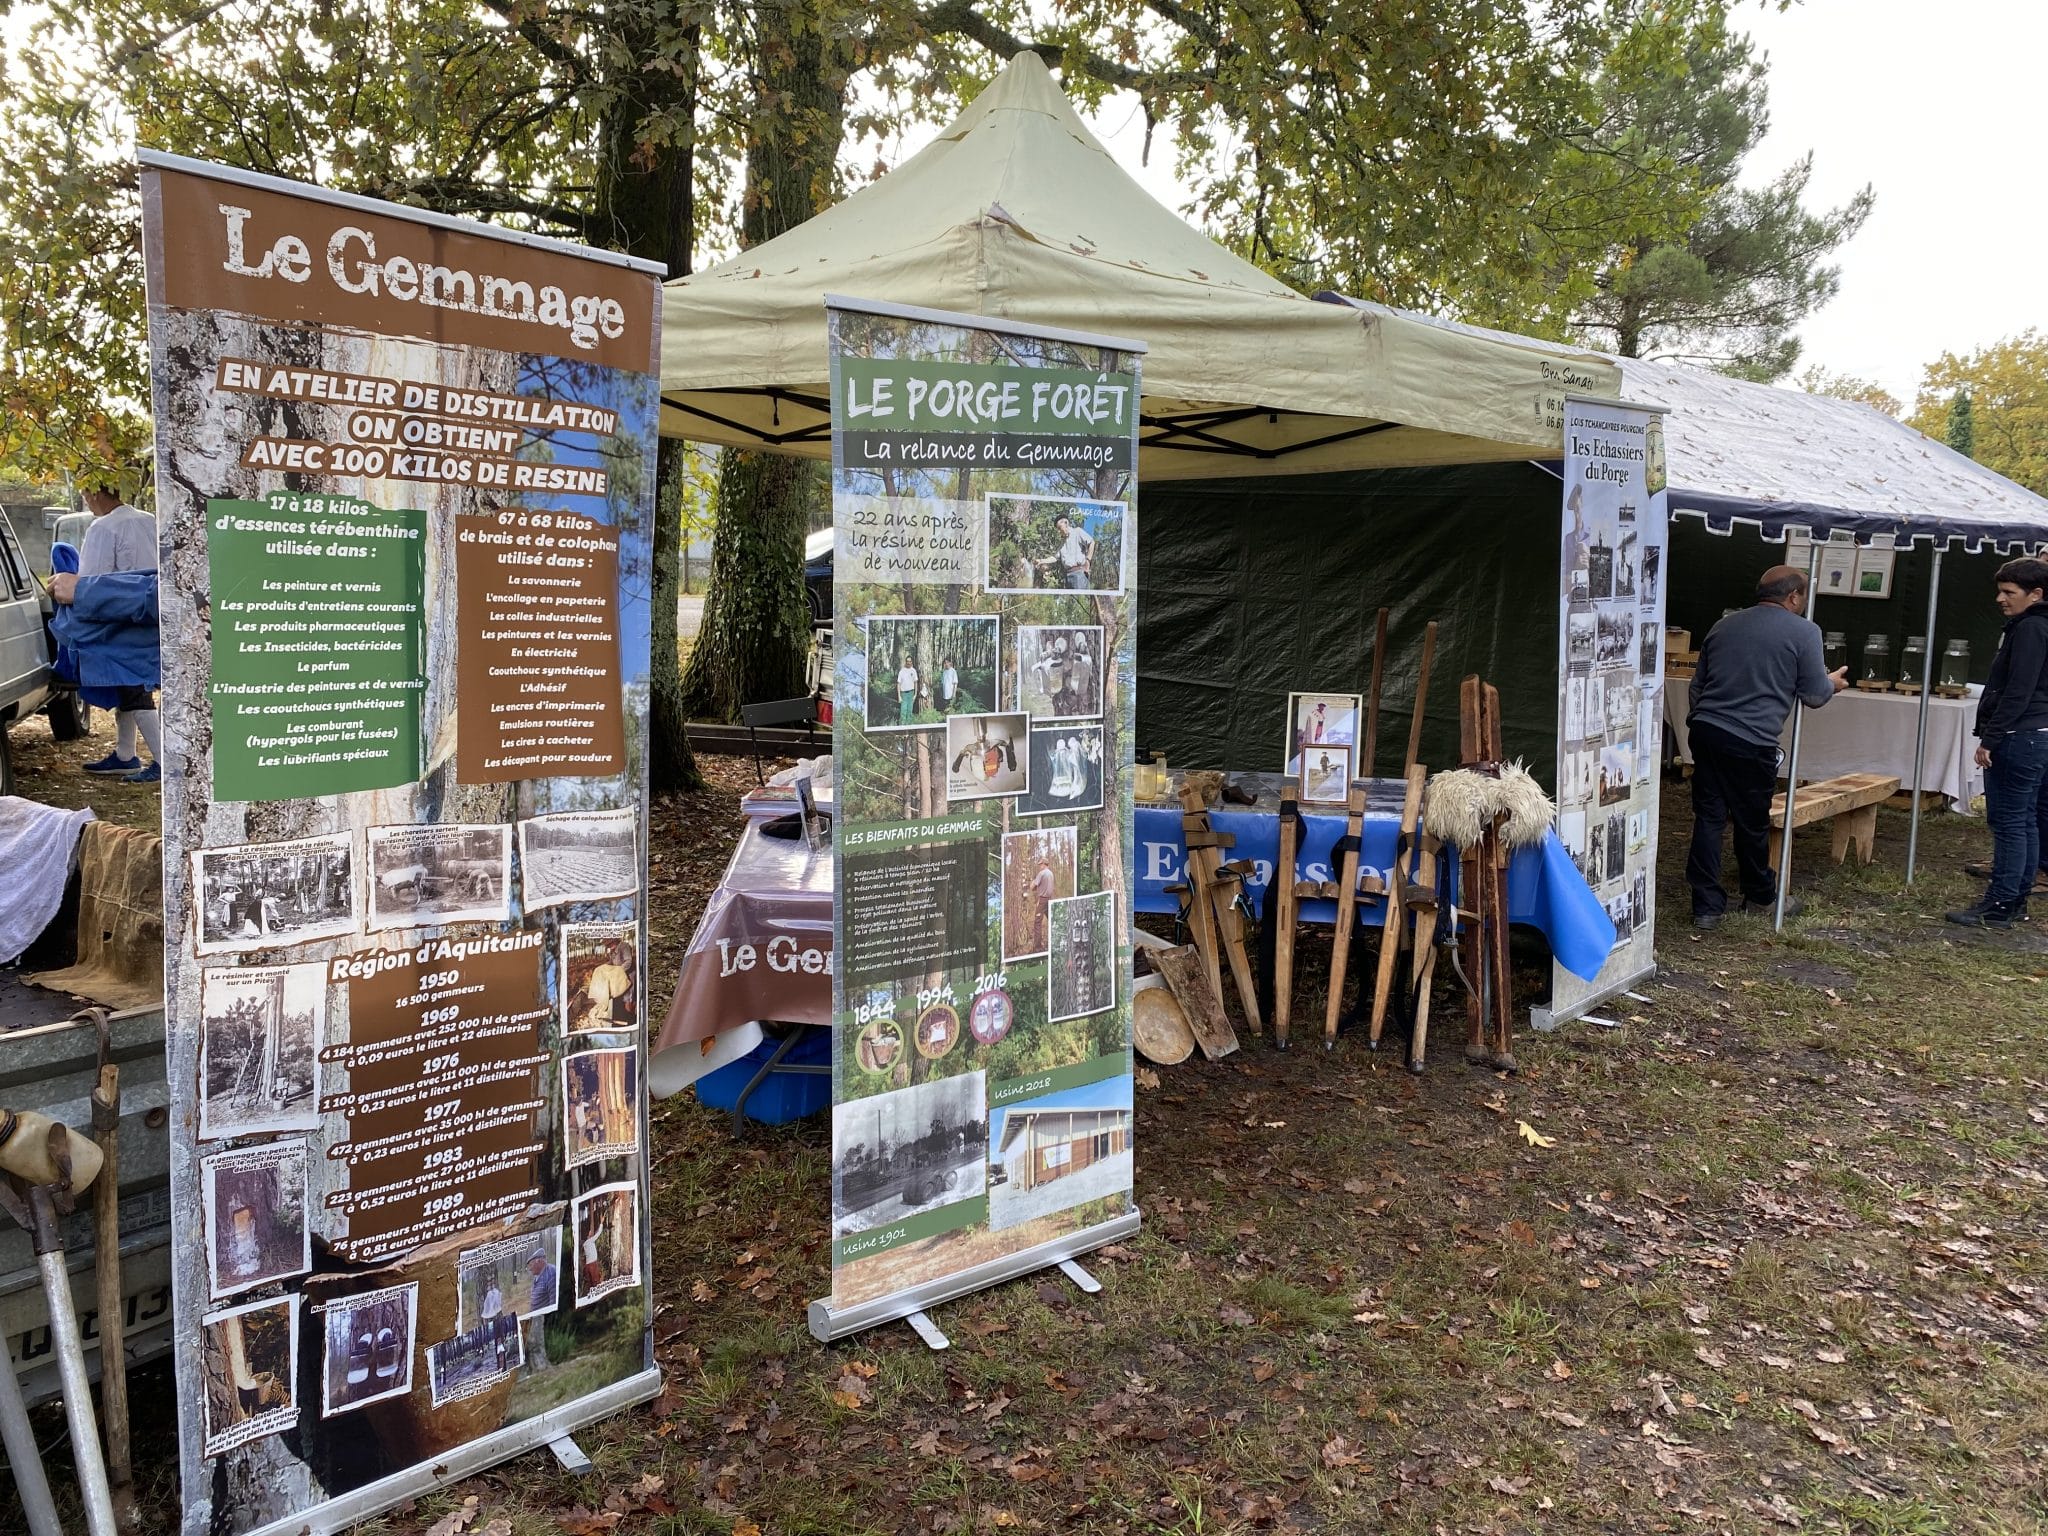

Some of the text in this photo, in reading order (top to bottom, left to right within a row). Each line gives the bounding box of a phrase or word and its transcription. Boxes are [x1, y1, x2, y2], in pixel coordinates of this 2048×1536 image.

[219, 203, 625, 350] Le Gemmage
[223, 363, 614, 433] EN ATELIER DE DISTILLATION
[847, 373, 1129, 425] LE PORGE FORÊT
[353, 414, 518, 452] ON OBTIENT
[863, 438, 1114, 468] La relance du Gemmage
[1572, 436, 1644, 461] les Echassiers
[249, 442, 606, 493] AVEC 100 KILOS DE RESINE
[1586, 462, 1629, 488] du Porge
[270, 496, 368, 516] 17 à 18 kilos
[310, 520, 419, 539] térébenthine
[498, 513, 592, 530] 67 à 68 kilos
[854, 511, 969, 532] 22 ans après,
[460, 529, 475, 542] de
[478, 530, 513, 545] brais
[516, 533, 531, 545] et
[535, 534, 554, 547] de
[852, 530, 971, 550] la résine coule
[266, 540, 321, 555] utilisée
[326, 543, 367, 557] dans
[498, 552, 542, 565] utilisé
[546, 554, 584, 568] dans
[864, 552, 961, 571] de nouveau
[263, 580, 381, 592] Les peinture et vernis
[509, 575, 581, 587] La savonnerie
[221, 600, 416, 613] Les produits d'entretiens courants
[486, 593, 606, 606] L'encollage en papeterie
[235, 622, 405, 633] Les produits pharmaceutiques
[490, 612, 602, 623] Les colles industrielles
[240, 641, 402, 652] Les Insecticides, bactéricides
[511, 648, 578, 657] En électricité
[298, 661, 349, 673] Le parfum
[489, 667, 606, 677] Caoutchouc synthétique
[213, 678, 424, 693] L'industrie des peintures et de vernis
[520, 683, 567, 692] L'Adhésif
[238, 699, 405, 714] Les caoutchoucs synthétiques
[491, 701, 605, 712] Les encres d'imprimerie
[287, 720, 364, 733] Les comburant
[500, 718, 594, 730] Emulsions routières
[246, 727, 398, 748] (hypergols pour les fusées)
[258, 749, 389, 766] Les lubrifiants spéciaux
[845, 820, 983, 845] LES BIENFAITS DU GEMMAGE
[332, 931, 543, 980] Région d'Aquitaine
[716, 937, 757, 977] Le
[419, 970, 459, 991] 1950
[974, 972, 1008, 994] 2016
[396, 984, 484, 1008] 16 500 gemmeurs
[916, 986, 954, 1010] 1994
[421, 1006, 460, 1026] 1969
[854, 999, 896, 1024] 1844
[423, 1053, 460, 1074] 1976
[1026, 1078, 1051, 1092] 2018
[424, 1100, 461, 1122] 1977
[423, 1146, 463, 1169] 1983
[423, 1193, 464, 1216] 1989
[879, 1228, 906, 1248] 1901
